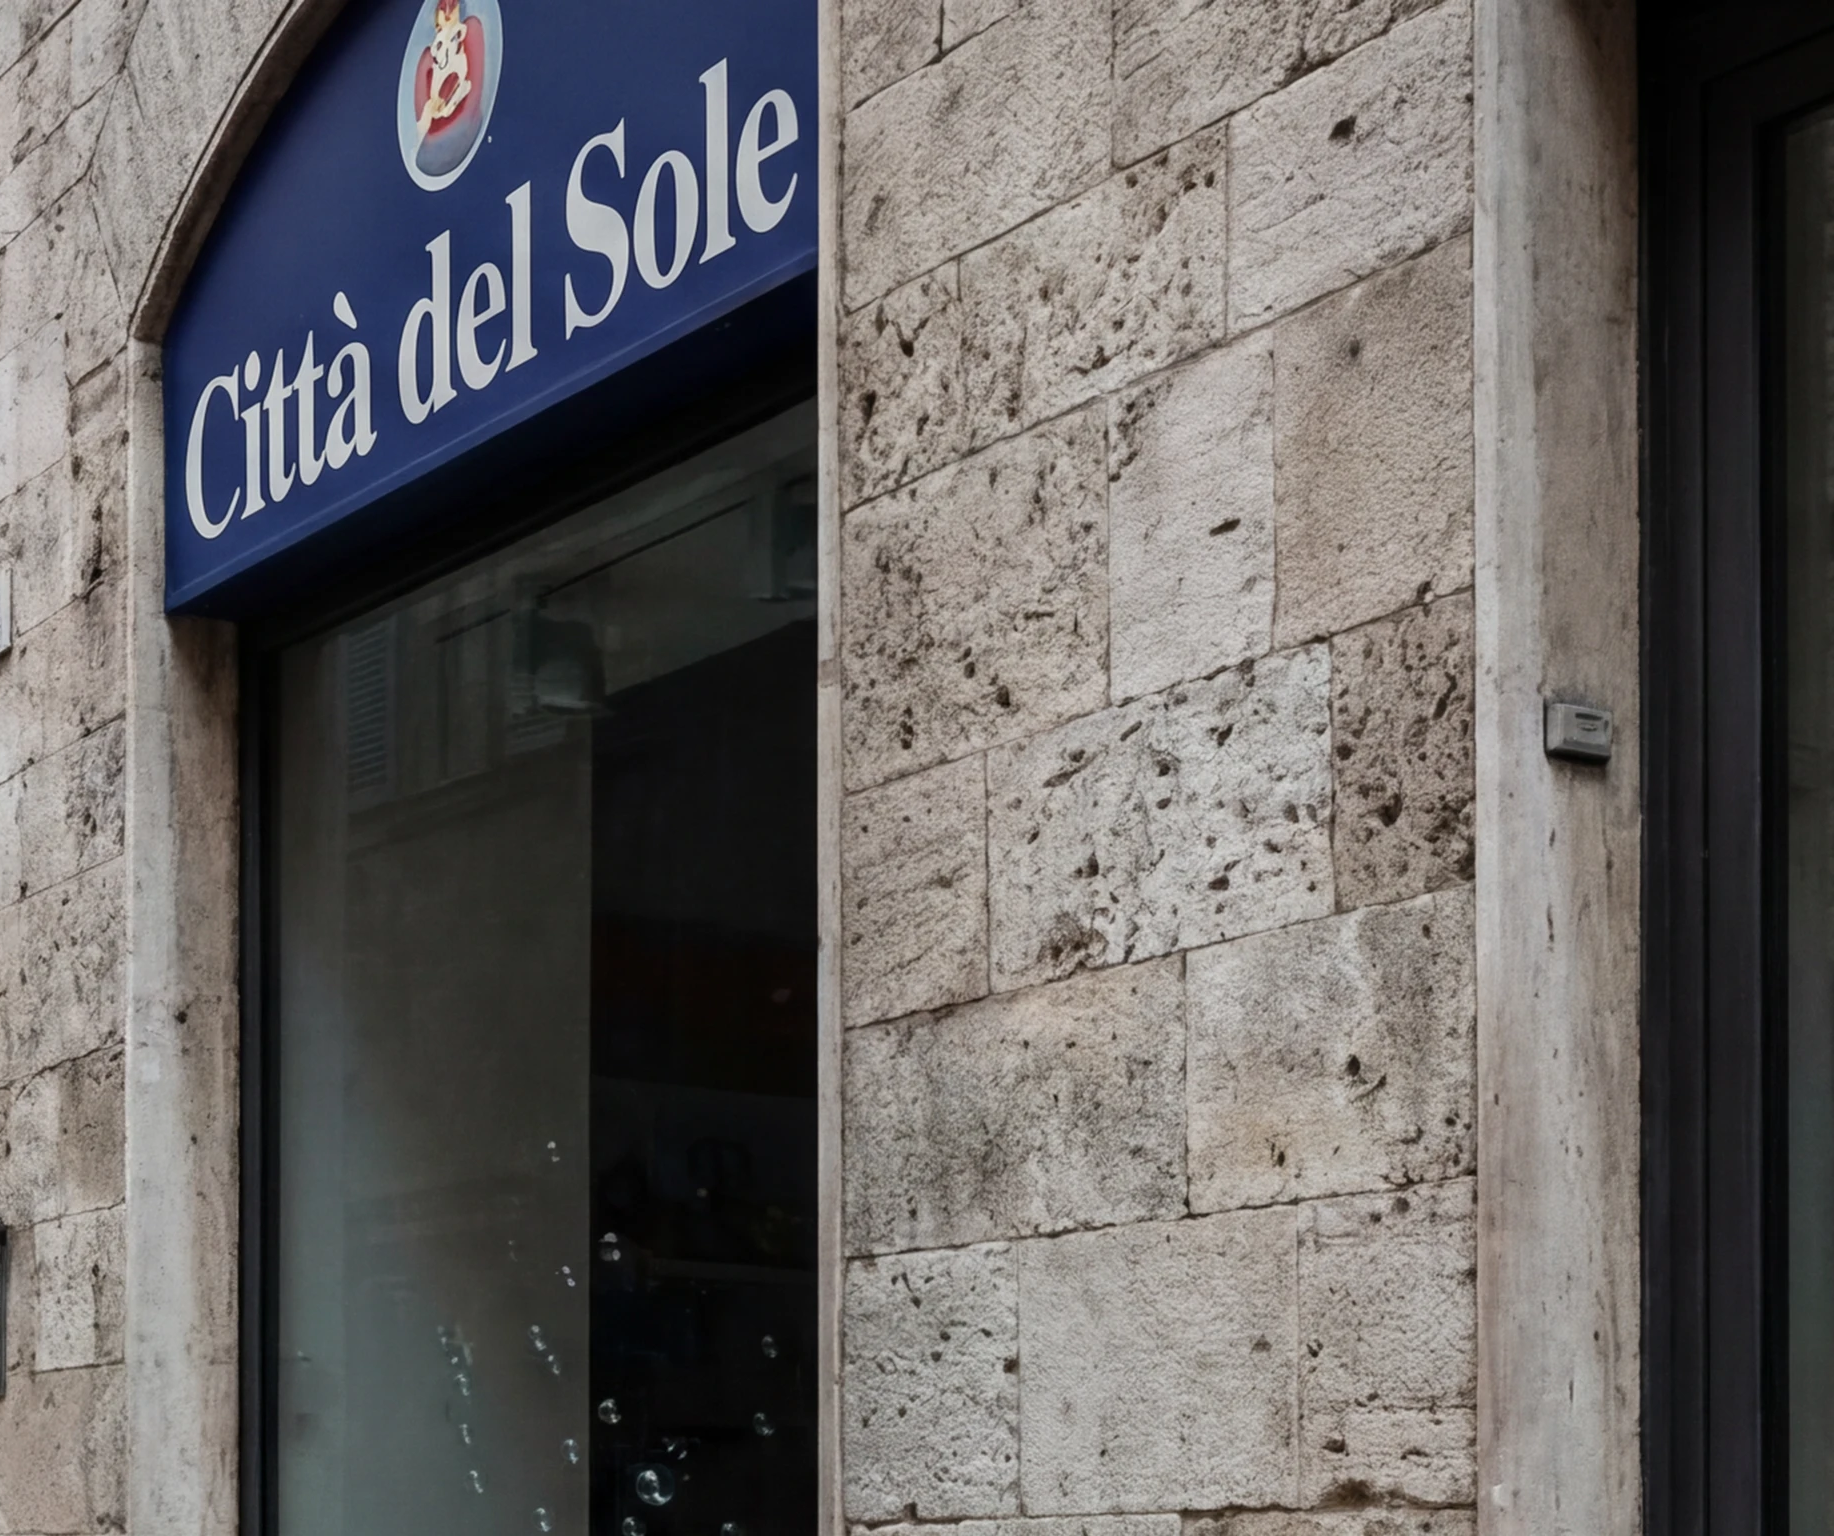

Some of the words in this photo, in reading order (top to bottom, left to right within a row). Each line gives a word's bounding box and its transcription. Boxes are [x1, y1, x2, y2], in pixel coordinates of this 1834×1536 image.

[185, 291, 378, 539] Città
[398, 180, 538, 424] del
[564, 57, 799, 340] Sole
